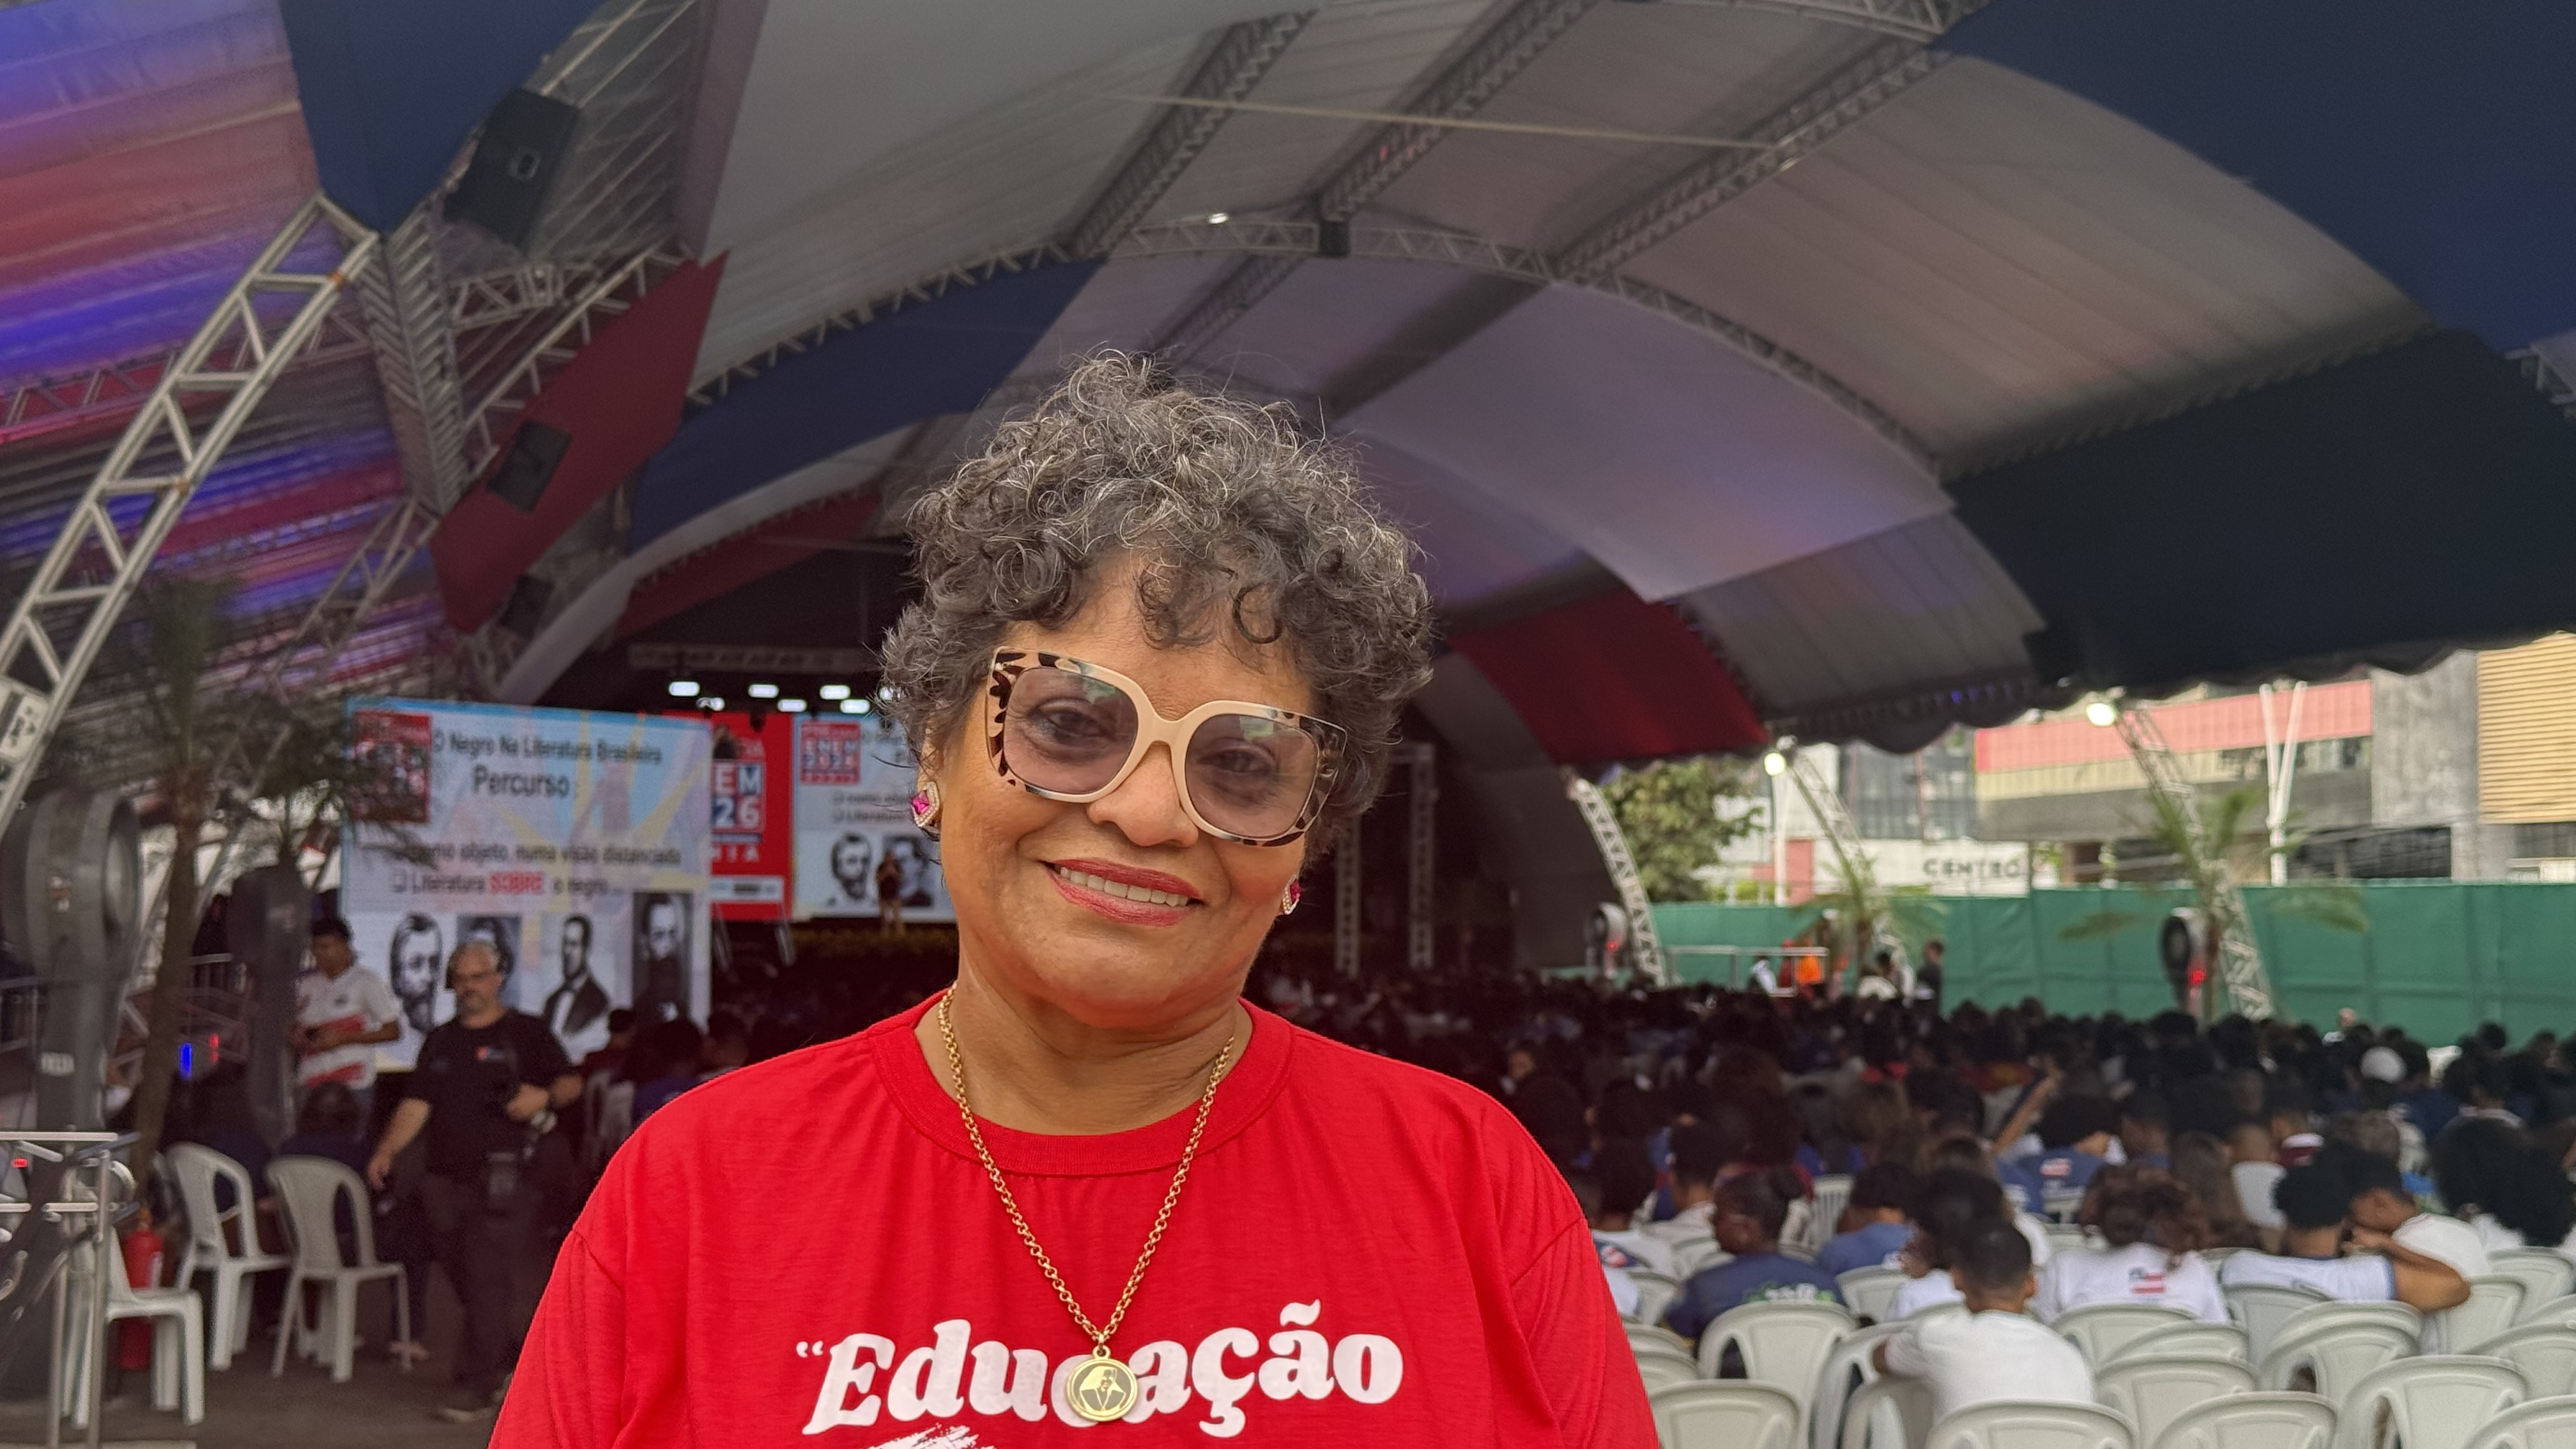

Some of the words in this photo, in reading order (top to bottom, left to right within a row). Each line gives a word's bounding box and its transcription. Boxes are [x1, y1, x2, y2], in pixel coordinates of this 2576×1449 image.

[449, 732, 494, 760] Negro
[500, 736, 519, 756] Na
[523, 737, 590, 760] Literatura
[597, 739, 662, 765] Brasileira
[473, 764, 570, 797] Percurso
[714, 763, 763, 796] EM
[714, 797, 760, 829] 26
[411, 871, 486, 894] Literatura
[490, 871, 544, 894] SOBRE
